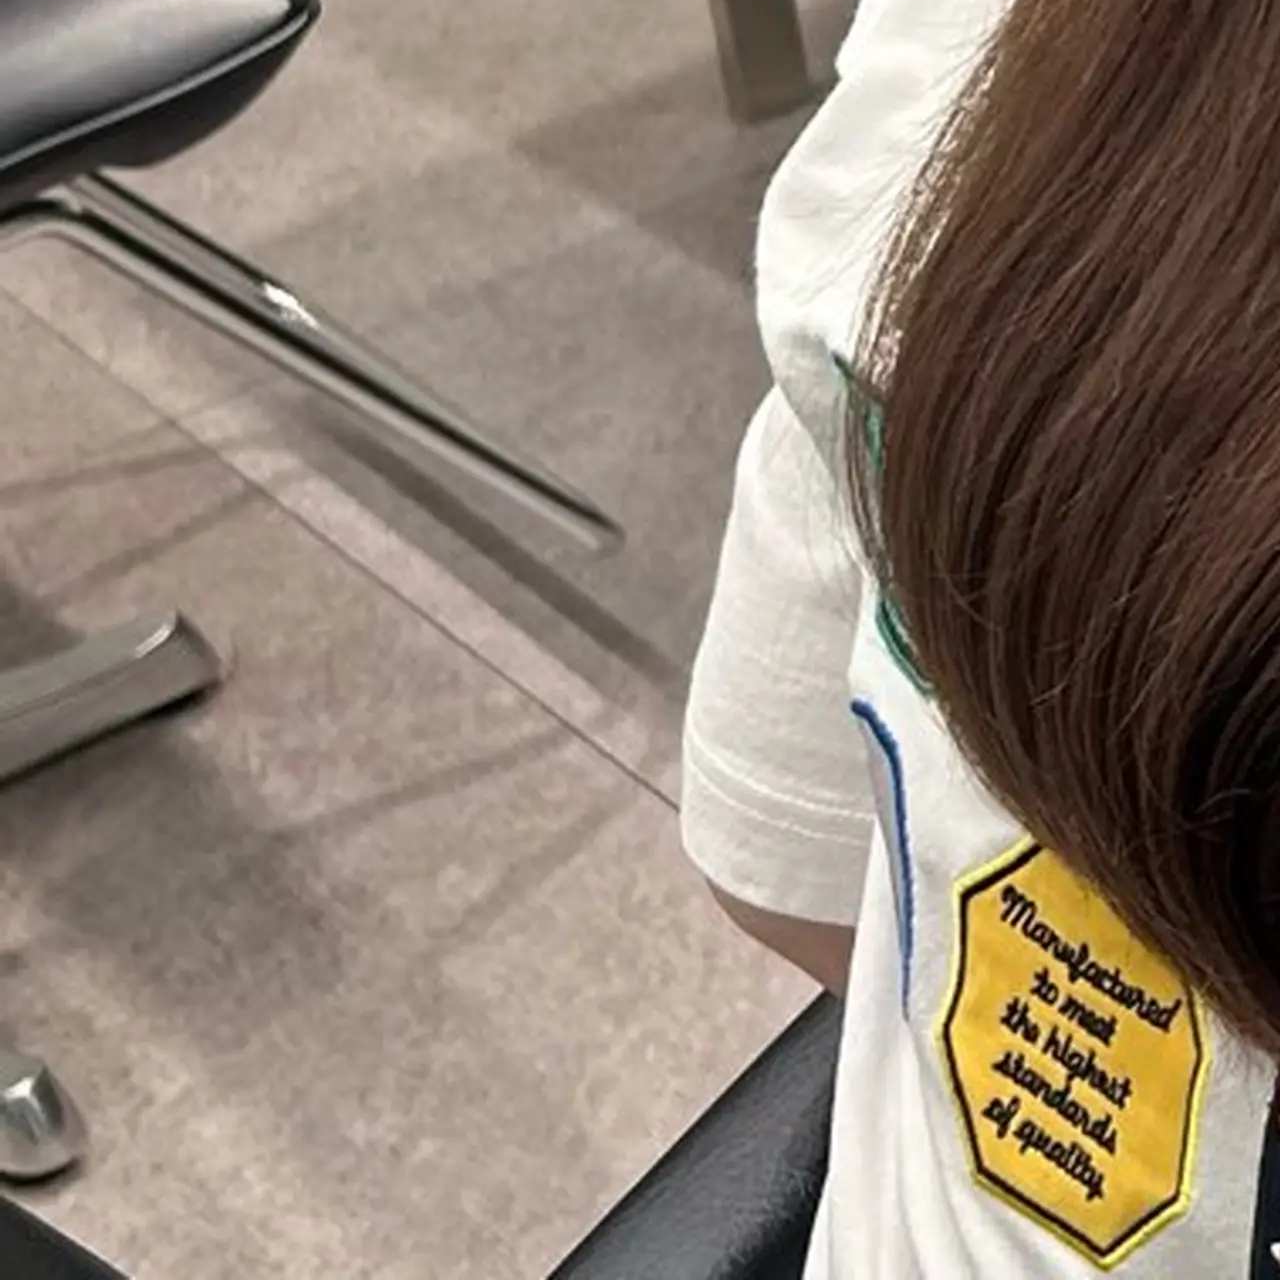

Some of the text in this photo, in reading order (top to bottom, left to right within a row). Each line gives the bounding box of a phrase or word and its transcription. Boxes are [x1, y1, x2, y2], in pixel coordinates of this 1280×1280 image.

[1001, 886, 1181, 1034] Manufactured
[1030, 967, 1117, 1047] to meet
[991, 1051, 1117, 1156] standards
[1000, 997, 1133, 1110] the highest
[982, 1097, 1104, 1200] of quality
